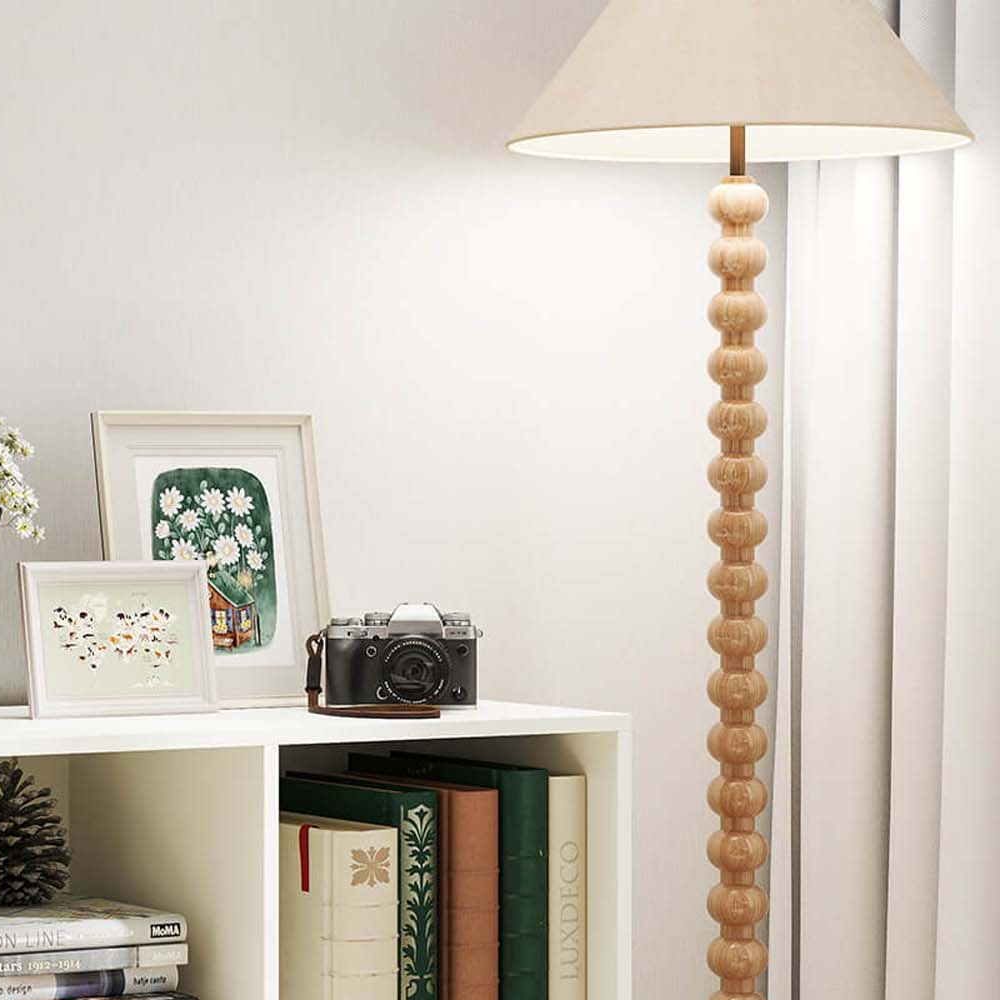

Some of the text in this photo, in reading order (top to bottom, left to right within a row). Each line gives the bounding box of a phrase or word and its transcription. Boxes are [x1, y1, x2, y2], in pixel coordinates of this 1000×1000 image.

[560, 841, 580, 981] LUXDECO
[26, 929, 65, 948] LINE
[152, 925, 180, 937] MoMA
[7, 983, 32, 996] design
